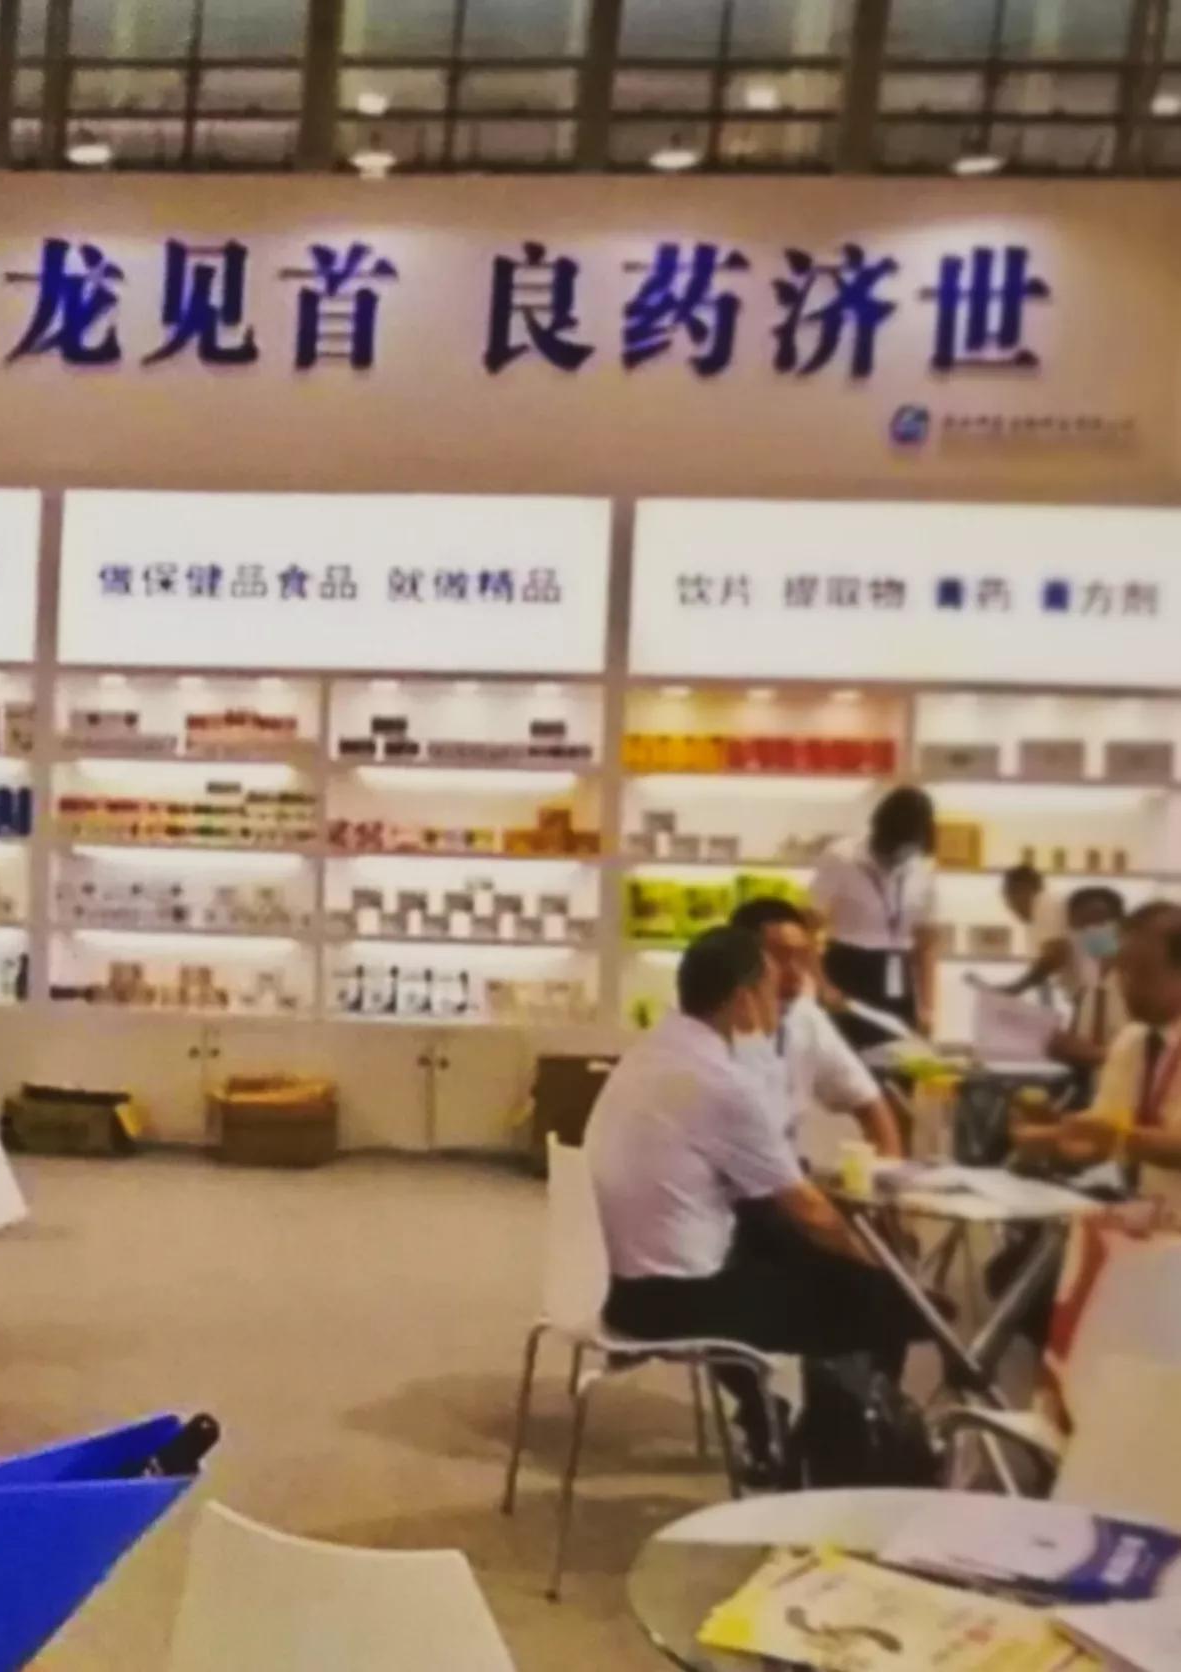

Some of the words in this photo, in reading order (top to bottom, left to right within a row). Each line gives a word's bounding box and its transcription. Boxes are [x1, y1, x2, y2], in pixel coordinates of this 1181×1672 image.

[482, 240, 1052, 379] 良药济世
[98, 563, 358, 600] 做保健品食品
[386, 566, 562, 605] 就做精品
[675, 573, 751, 607] 饮片
[783, 575, 907, 610] 提取物
